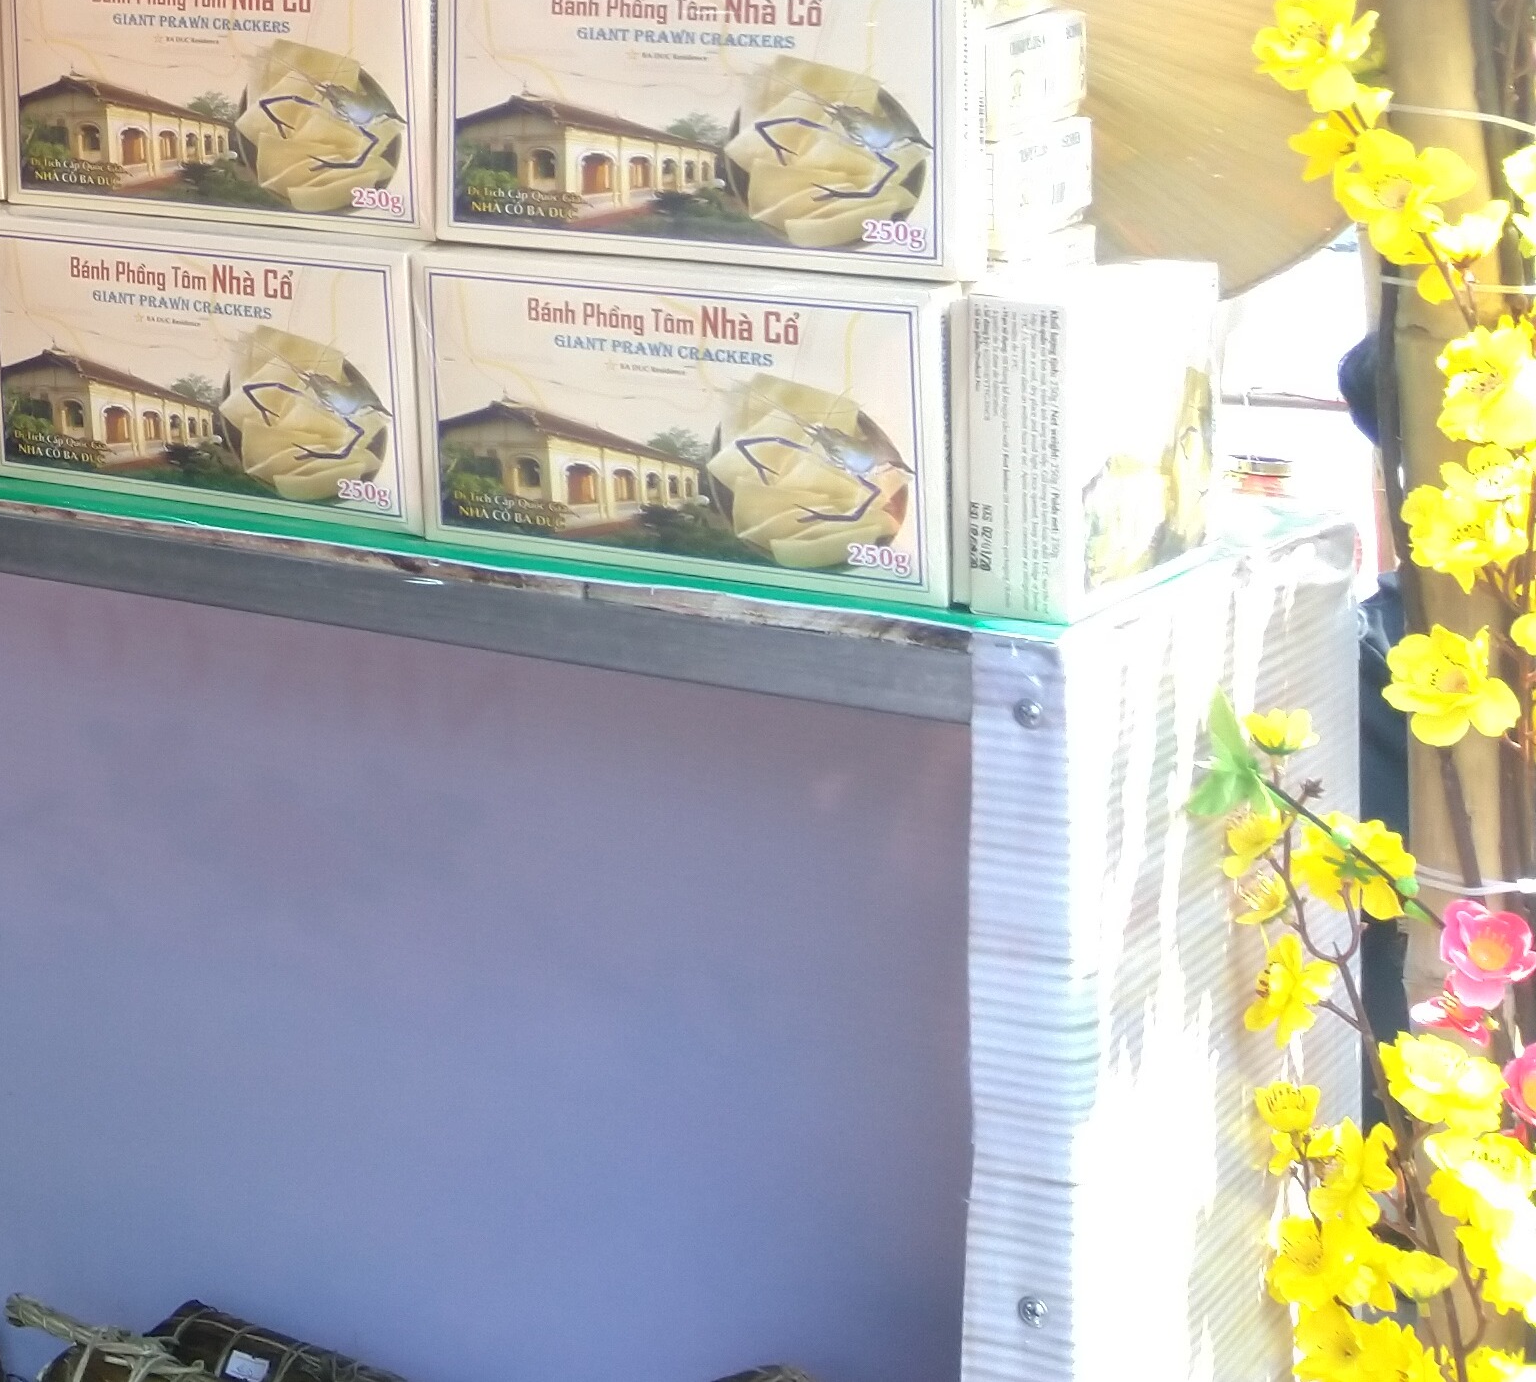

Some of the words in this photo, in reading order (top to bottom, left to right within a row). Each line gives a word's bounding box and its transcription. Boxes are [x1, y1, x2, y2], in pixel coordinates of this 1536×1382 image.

[112, 13, 156, 27] GIANT
[159, 15, 209, 29] PRAWN
[212, 17, 290, 33] CRACKERS
[576, 27, 630, 42] GIANT
[633, 29, 695, 44] PRAWN
[699, 32, 795, 49] CRACKERS
[351, 187, 403, 216] 250g
[862, 219, 925, 251] 250g
[70, 257, 110, 281] Bánh
[115, 261, 166, 292] Phồng
[170, 266, 206, 291] Tôm
[211, 263, 255, 296] Nhà
[263, 268, 293, 300] Cổ
[92, 290, 136, 305] GIANT
[139, 294, 190, 310] PRAWN
[193, 300, 272, 319] CRACKERS
[527, 297, 576, 325] Bánh
[582, 302, 644, 336] Phồng
[651, 308, 694, 335] Tôm
[700, 305, 753, 342] Nhà
[763, 310, 800, 345] Cổ
[553, 334, 607, 351] GIANT
[611, 339, 673, 357] PRAWN
[677, 345, 773, 367] CRACKERS
[337, 478, 390, 510] 250g
[847, 543, 910, 577] 250g
